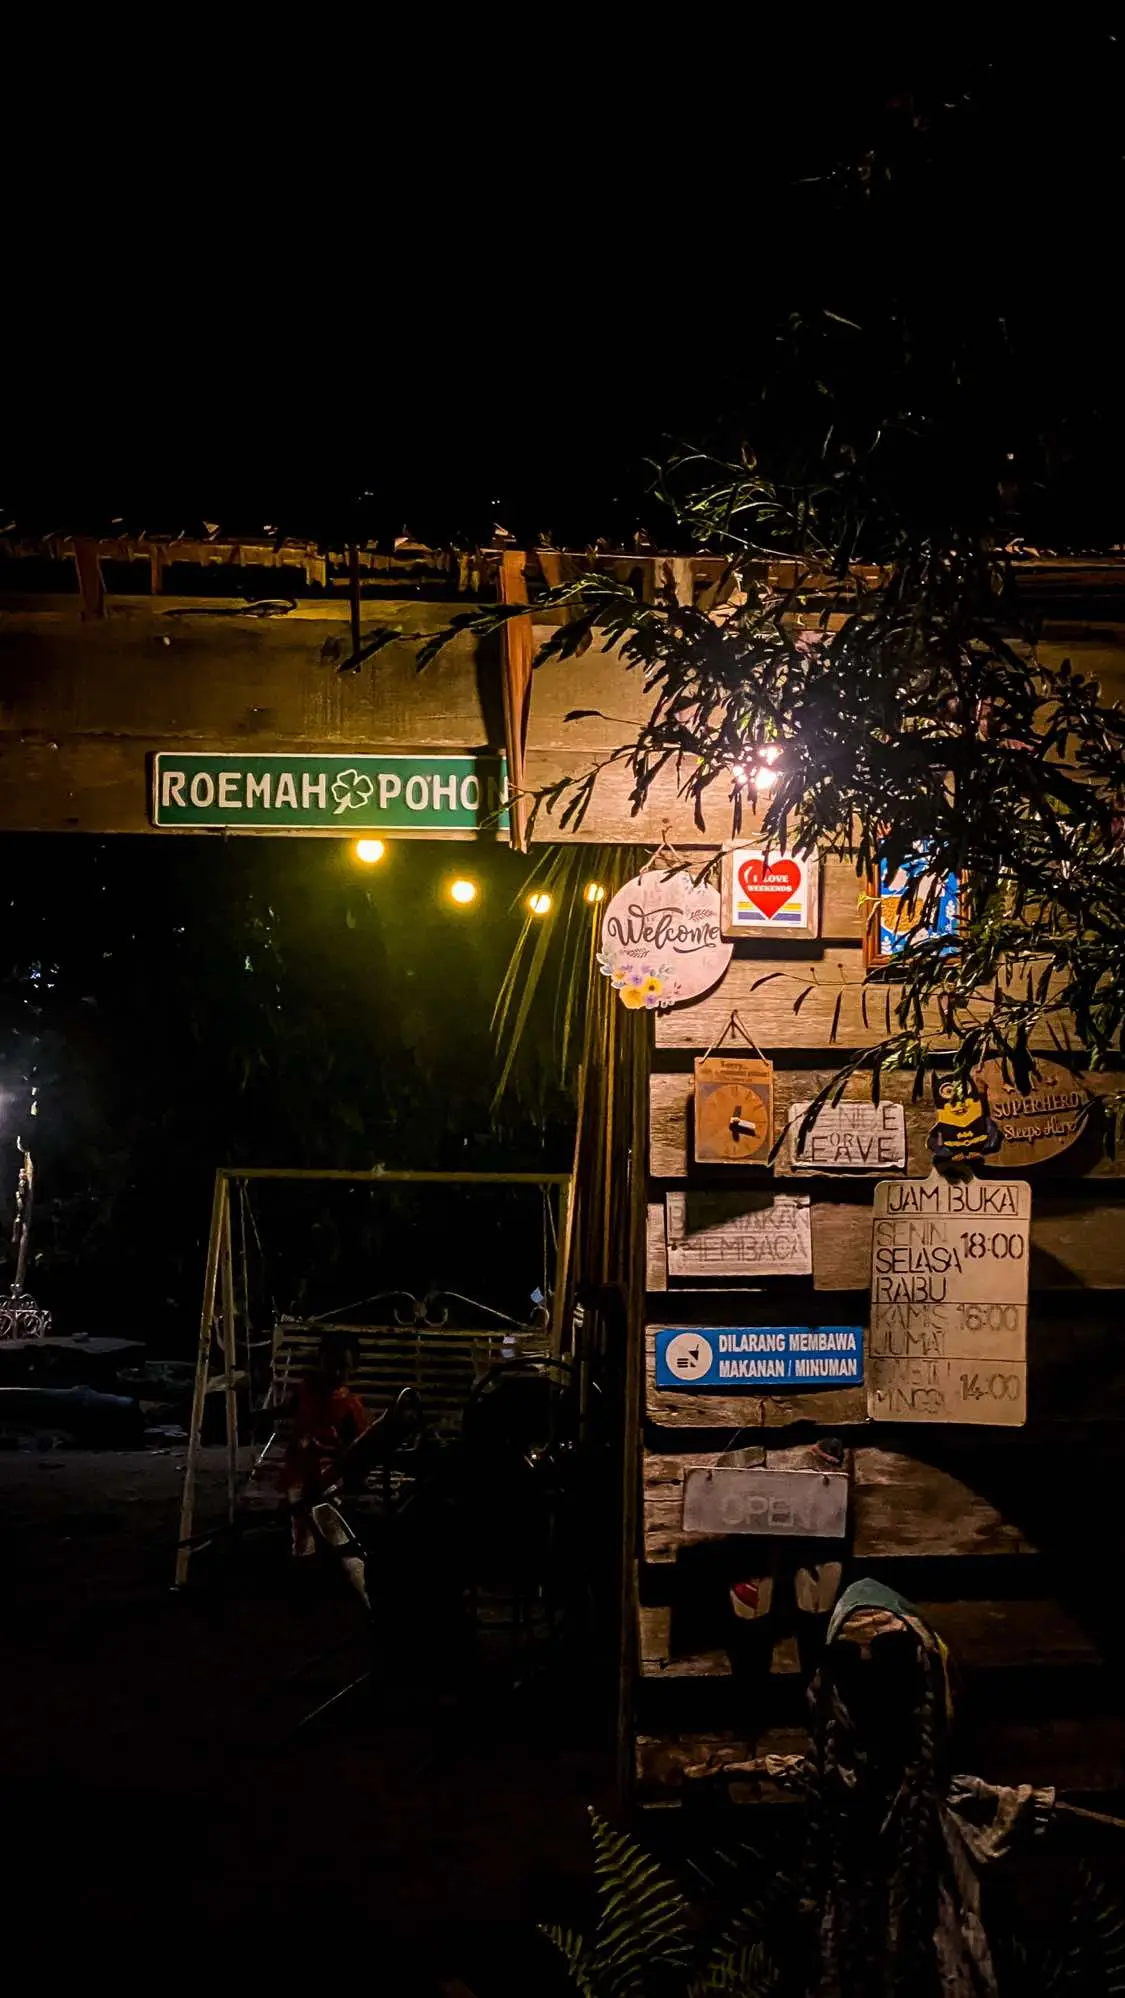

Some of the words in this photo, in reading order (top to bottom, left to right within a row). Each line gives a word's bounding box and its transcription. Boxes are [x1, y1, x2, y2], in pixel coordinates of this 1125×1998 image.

[162, 770, 326, 809] ROEMAH
[747, 885, 793, 893] WEEKENDS
[607, 904, 721, 954] Welcome
[993, 1091, 1080, 1118] SUPERHERO
[829, 1131, 855, 1147] OR
[888, 1186, 939, 1214] JAM
[948, 1186, 1016, 1214] BUKA
[875, 1222, 949, 1246] SENIN
[960, 1232, 1025, 1260] 18:00
[875, 1247, 962, 1275] SELASA
[875, 1277, 948, 1303] RABU
[718, 1333, 785, 1353] DILARANG
[789, 1332, 857, 1352] MEMBAWA
[719, 1359, 785, 1378] MAKANAN
[795, 1358, 857, 1377] MINUMAN
